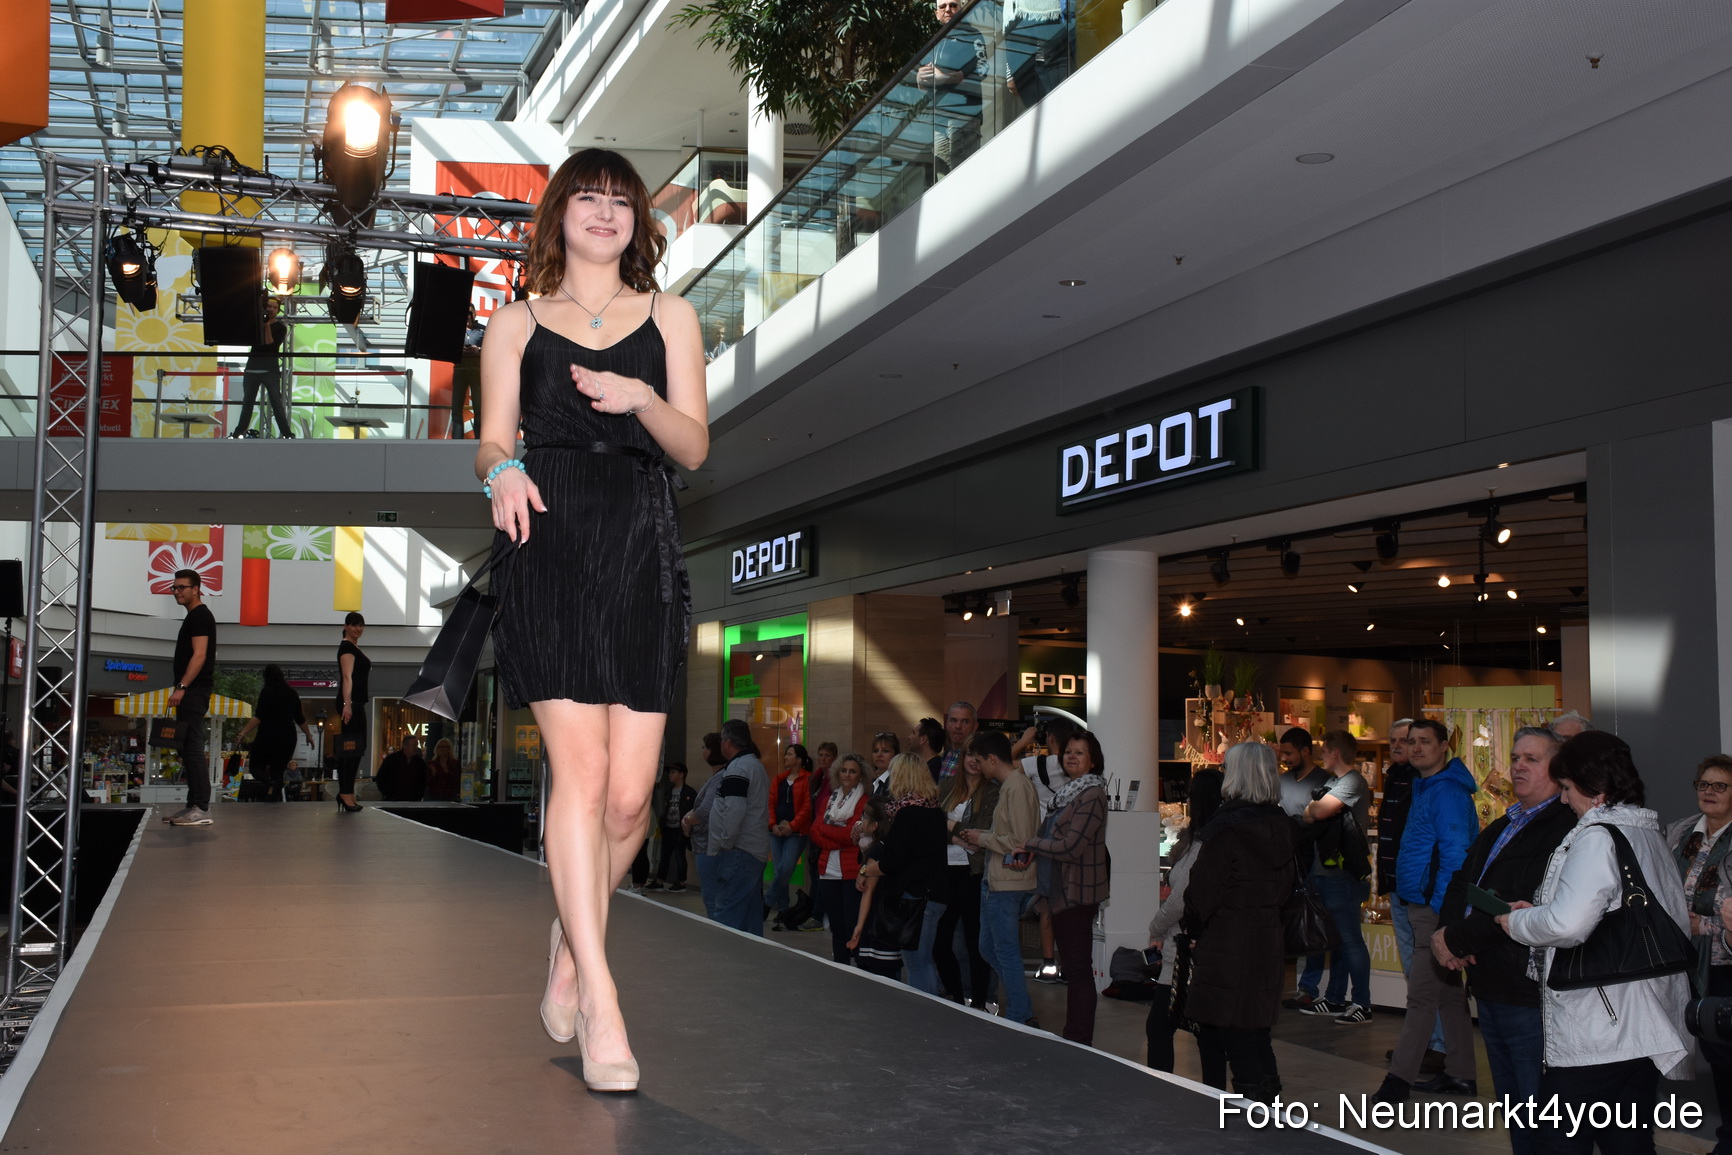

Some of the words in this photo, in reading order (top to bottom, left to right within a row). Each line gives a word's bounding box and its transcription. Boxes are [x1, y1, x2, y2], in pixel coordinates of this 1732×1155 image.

[1062, 398, 1233, 498] DEPOT
[732, 531, 801, 584] DEPOT
[105, 659, 144, 672] Spielwaren
